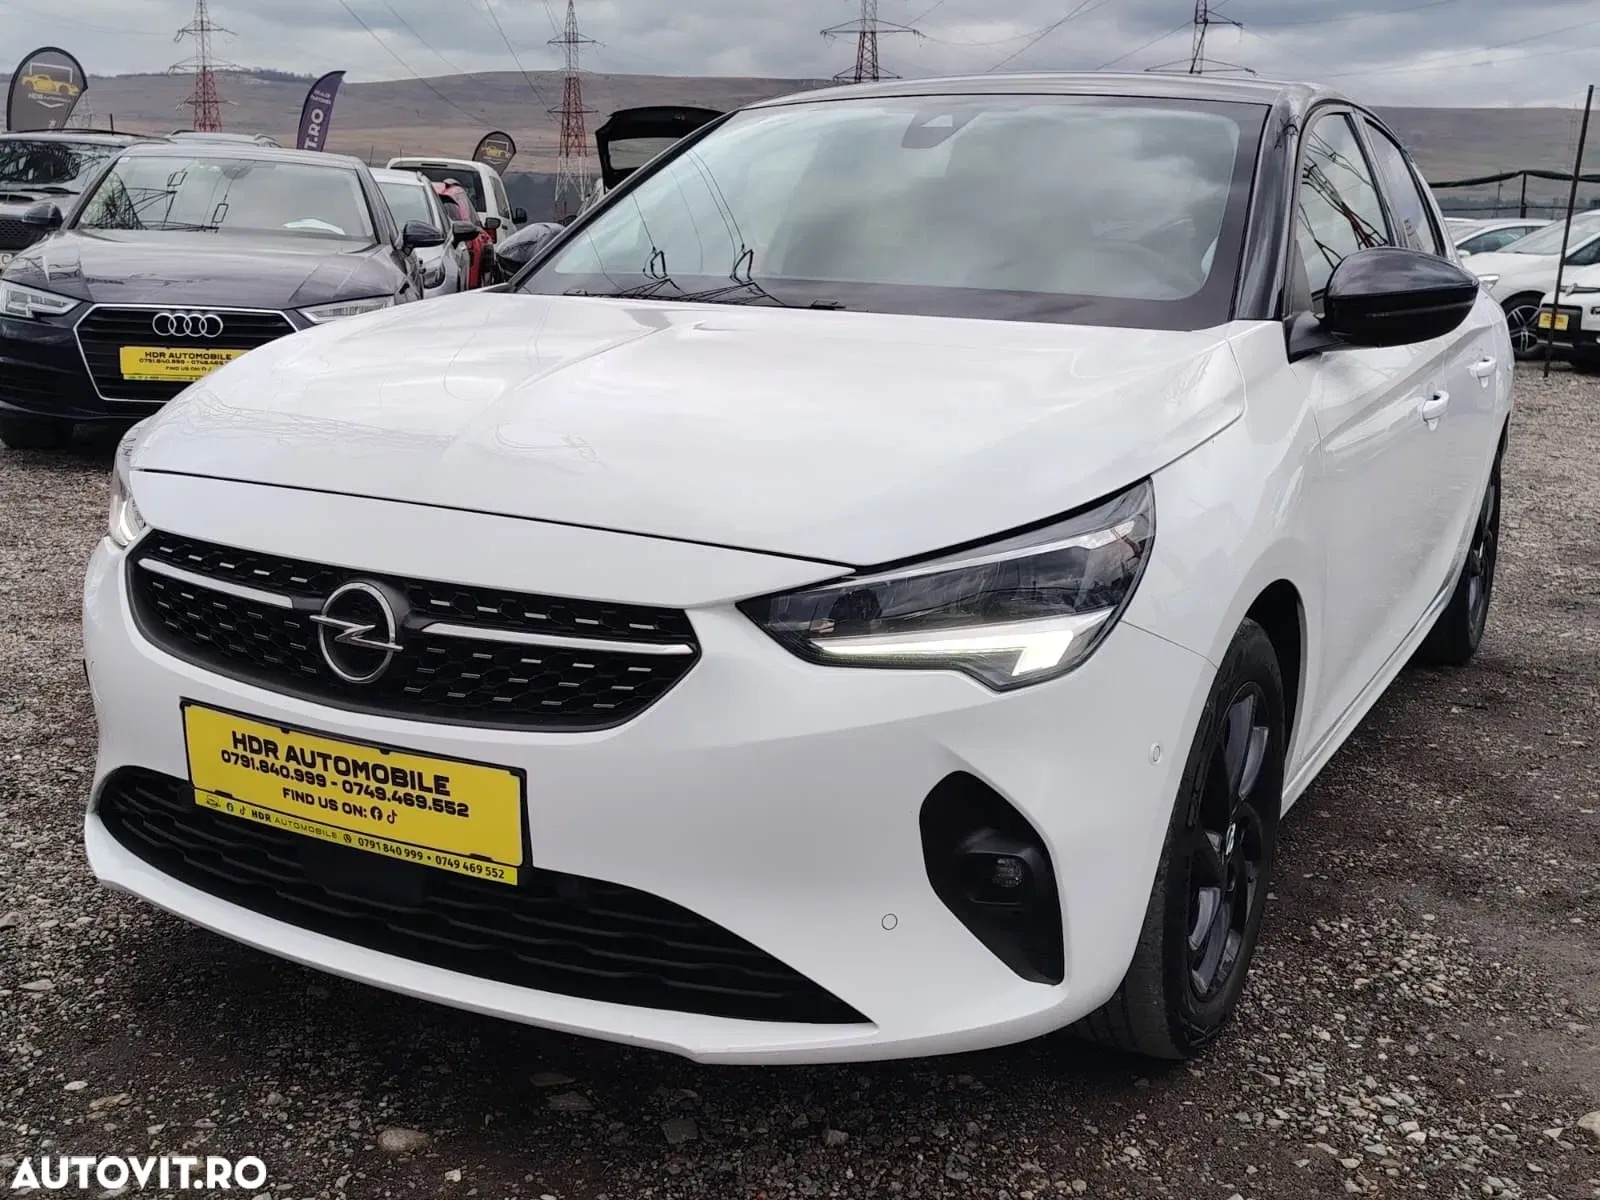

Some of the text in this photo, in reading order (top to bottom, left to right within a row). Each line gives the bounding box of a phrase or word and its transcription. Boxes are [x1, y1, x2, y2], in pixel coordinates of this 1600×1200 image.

[145, 351, 233, 361] HDR AUTOMOBILE
[221, 749, 327, 788] 0791.840.999
[341, 780, 470, 818] 0749.469.552
[231, 730, 450, 796] HDR AUTOMOBILE
[282, 787, 368, 819] FIND US ON:
[251, 809, 505, 880] HDR AUTOMOBILE 0791 840 999 0749 469 552
